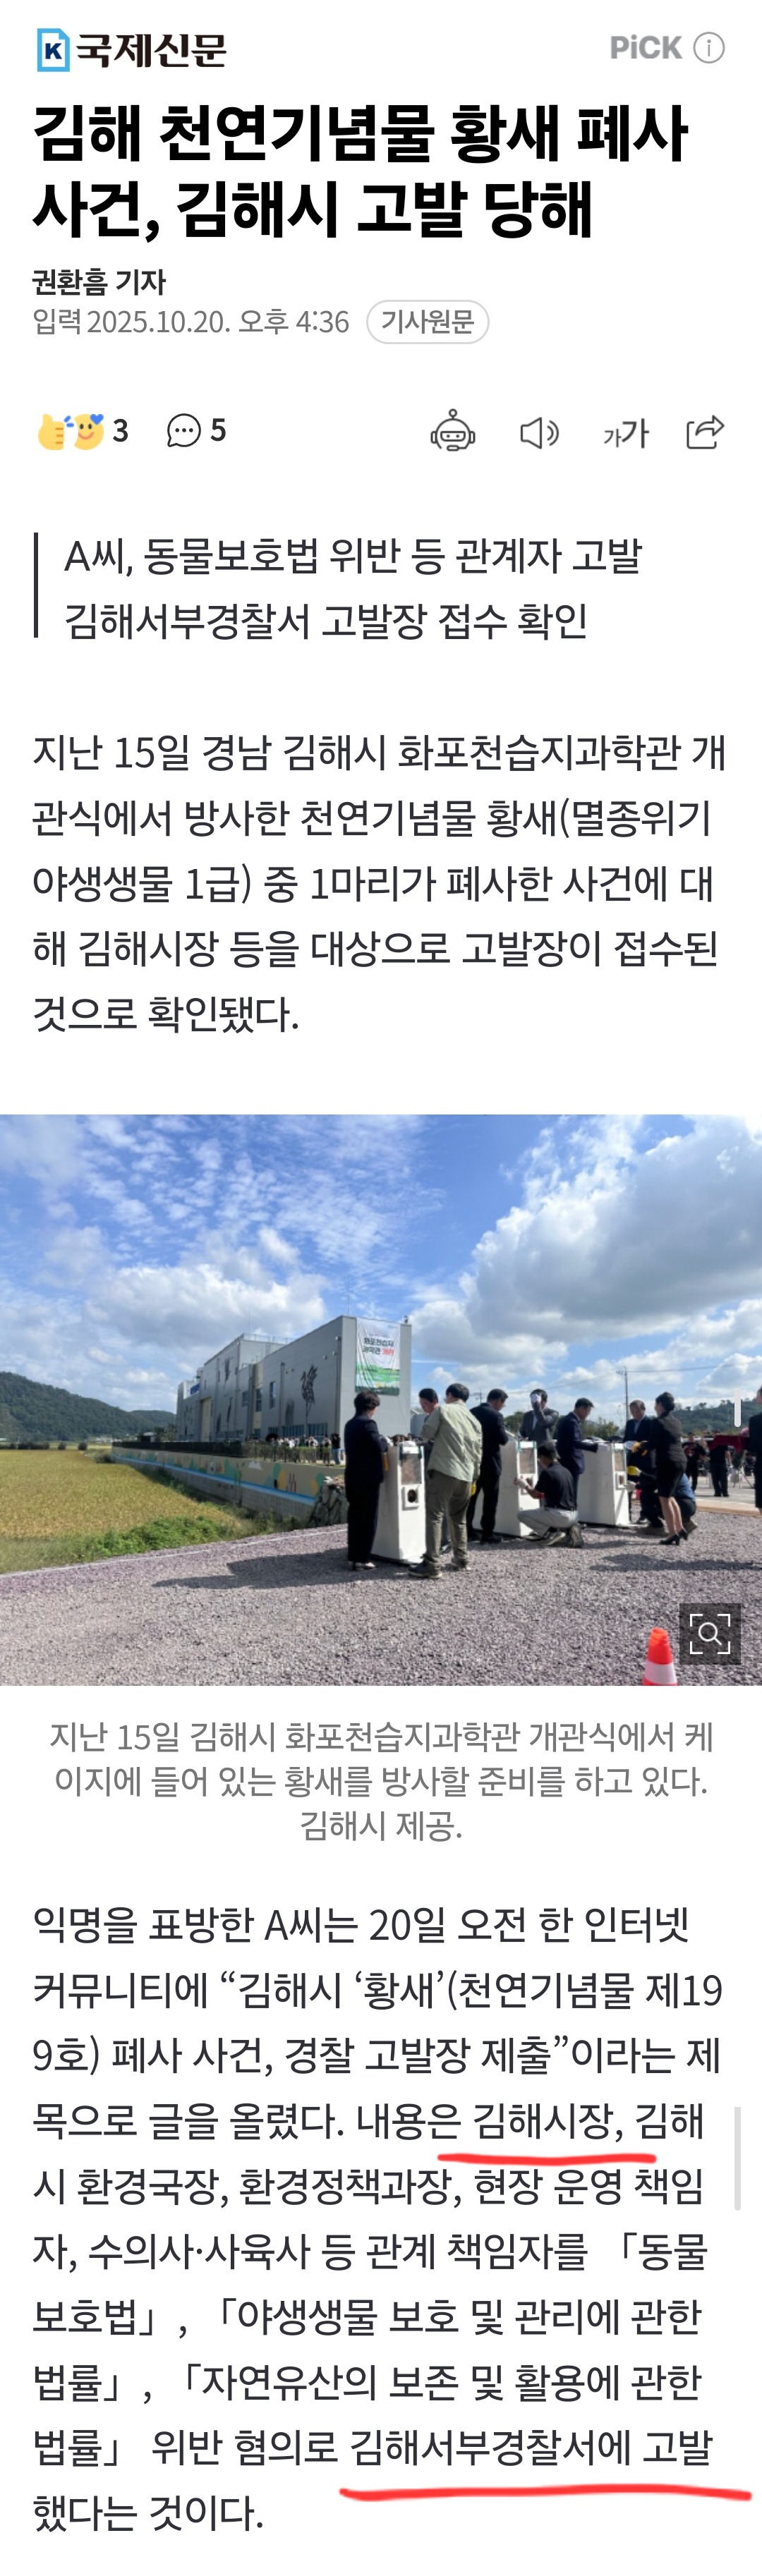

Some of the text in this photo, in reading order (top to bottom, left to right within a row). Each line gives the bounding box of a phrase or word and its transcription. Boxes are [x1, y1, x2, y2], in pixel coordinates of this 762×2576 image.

[76, 34, 226, 68] 국제신문
[612, 35, 682, 59] PiCK
[34, 104, 689, 164] 김해 천연기념물 황새 폐사
[32, 181, 591, 243] 사건, 김해시 고발 당해
[32, 268, 166, 296] 권환흠 기자
[34, 309, 349, 334] 입력 2025.10.20. 오후 4:36
[382, 310, 474, 334] 기사원문
[113, 419, 128, 442] 3
[210, 418, 226, 442] 5
[64, 538, 642, 577] A씨, 동물보호법 위반 등 관계자 고발
[66, 604, 586, 640] 김해서부경찰서 고발장 접수 확인
[34, 735, 724, 771] 지난 15일 경남 김해시 화포천습지과학관 개
[32, 798, 708, 838] 관식에서 방사한 천연기념물 황새(멸종위기
[34, 863, 711, 904] 야생생물 1급) 중 1마리가 폐사한 사건에 대
[33, 931, 716, 968] 해 김해시장 등을 대상으로 고발장이 접수된
[34, 997, 298, 1033] 것으로 확인됐다.
[50, 1722, 711, 1752] 지난 15일 김해시 화포천습지과학관 개관식에서 케
[56, 1767, 706, 1797] 이지에 들어 있는 황새를 방사할 준비를 하고 있다.
[301, 1811, 461, 1842] 김해시 제공.
[35, 1907, 688, 1943] 익명을 표방한 A씨는 20일 오전 한 인터넷
[35, 1973, 206, 2009] 커뮤니티에
[646, 1973, 722, 2008] 제19
[33, 2035, 99, 2075] 9호)
[112, 2038, 182, 2073] 폐사
[193, 2038, 272, 2077] 사건,
[286, 2038, 354, 2074] 경찰
[365, 2038, 471, 2074] 고발장
[687, 2038, 718, 2073] 제
[33, 2103, 702, 2142] 목으로 글을 올렸다. 내용은 김해시장, 김해
[34, 2169, 701, 2208] 시 환경국장, 환경정책과장, 현장 운영 책임
[32, 2234, 76, 2273] 자,
[89, 2234, 310, 2270] 수의사·사육사
[322, 2235, 355, 2271] 등
[367, 2234, 434, 2269] 관계
[448, 2234, 588, 2271] 책임자를
[389, 2300, 459, 2332] 보호
[473, 2299, 503, 2335] 및
[515, 2299, 618, 2335] 관리에
[631, 2299, 702, 2335] 관한
[389, 2366, 459, 2400] 보존
[473, 2365, 503, 2400] 및
[515, 2365, 618, 2402] 활용에
[631, 2365, 702, 2400] 관한
[152, 2430, 223, 2465] 위반
[235, 2430, 338, 2465] 혐의로
[351, 2430, 629, 2466] 김해서부경찰서에
[643, 2430, 713, 2465] 고발
[33, 2496, 262, 2532] 했다는 것이다.
